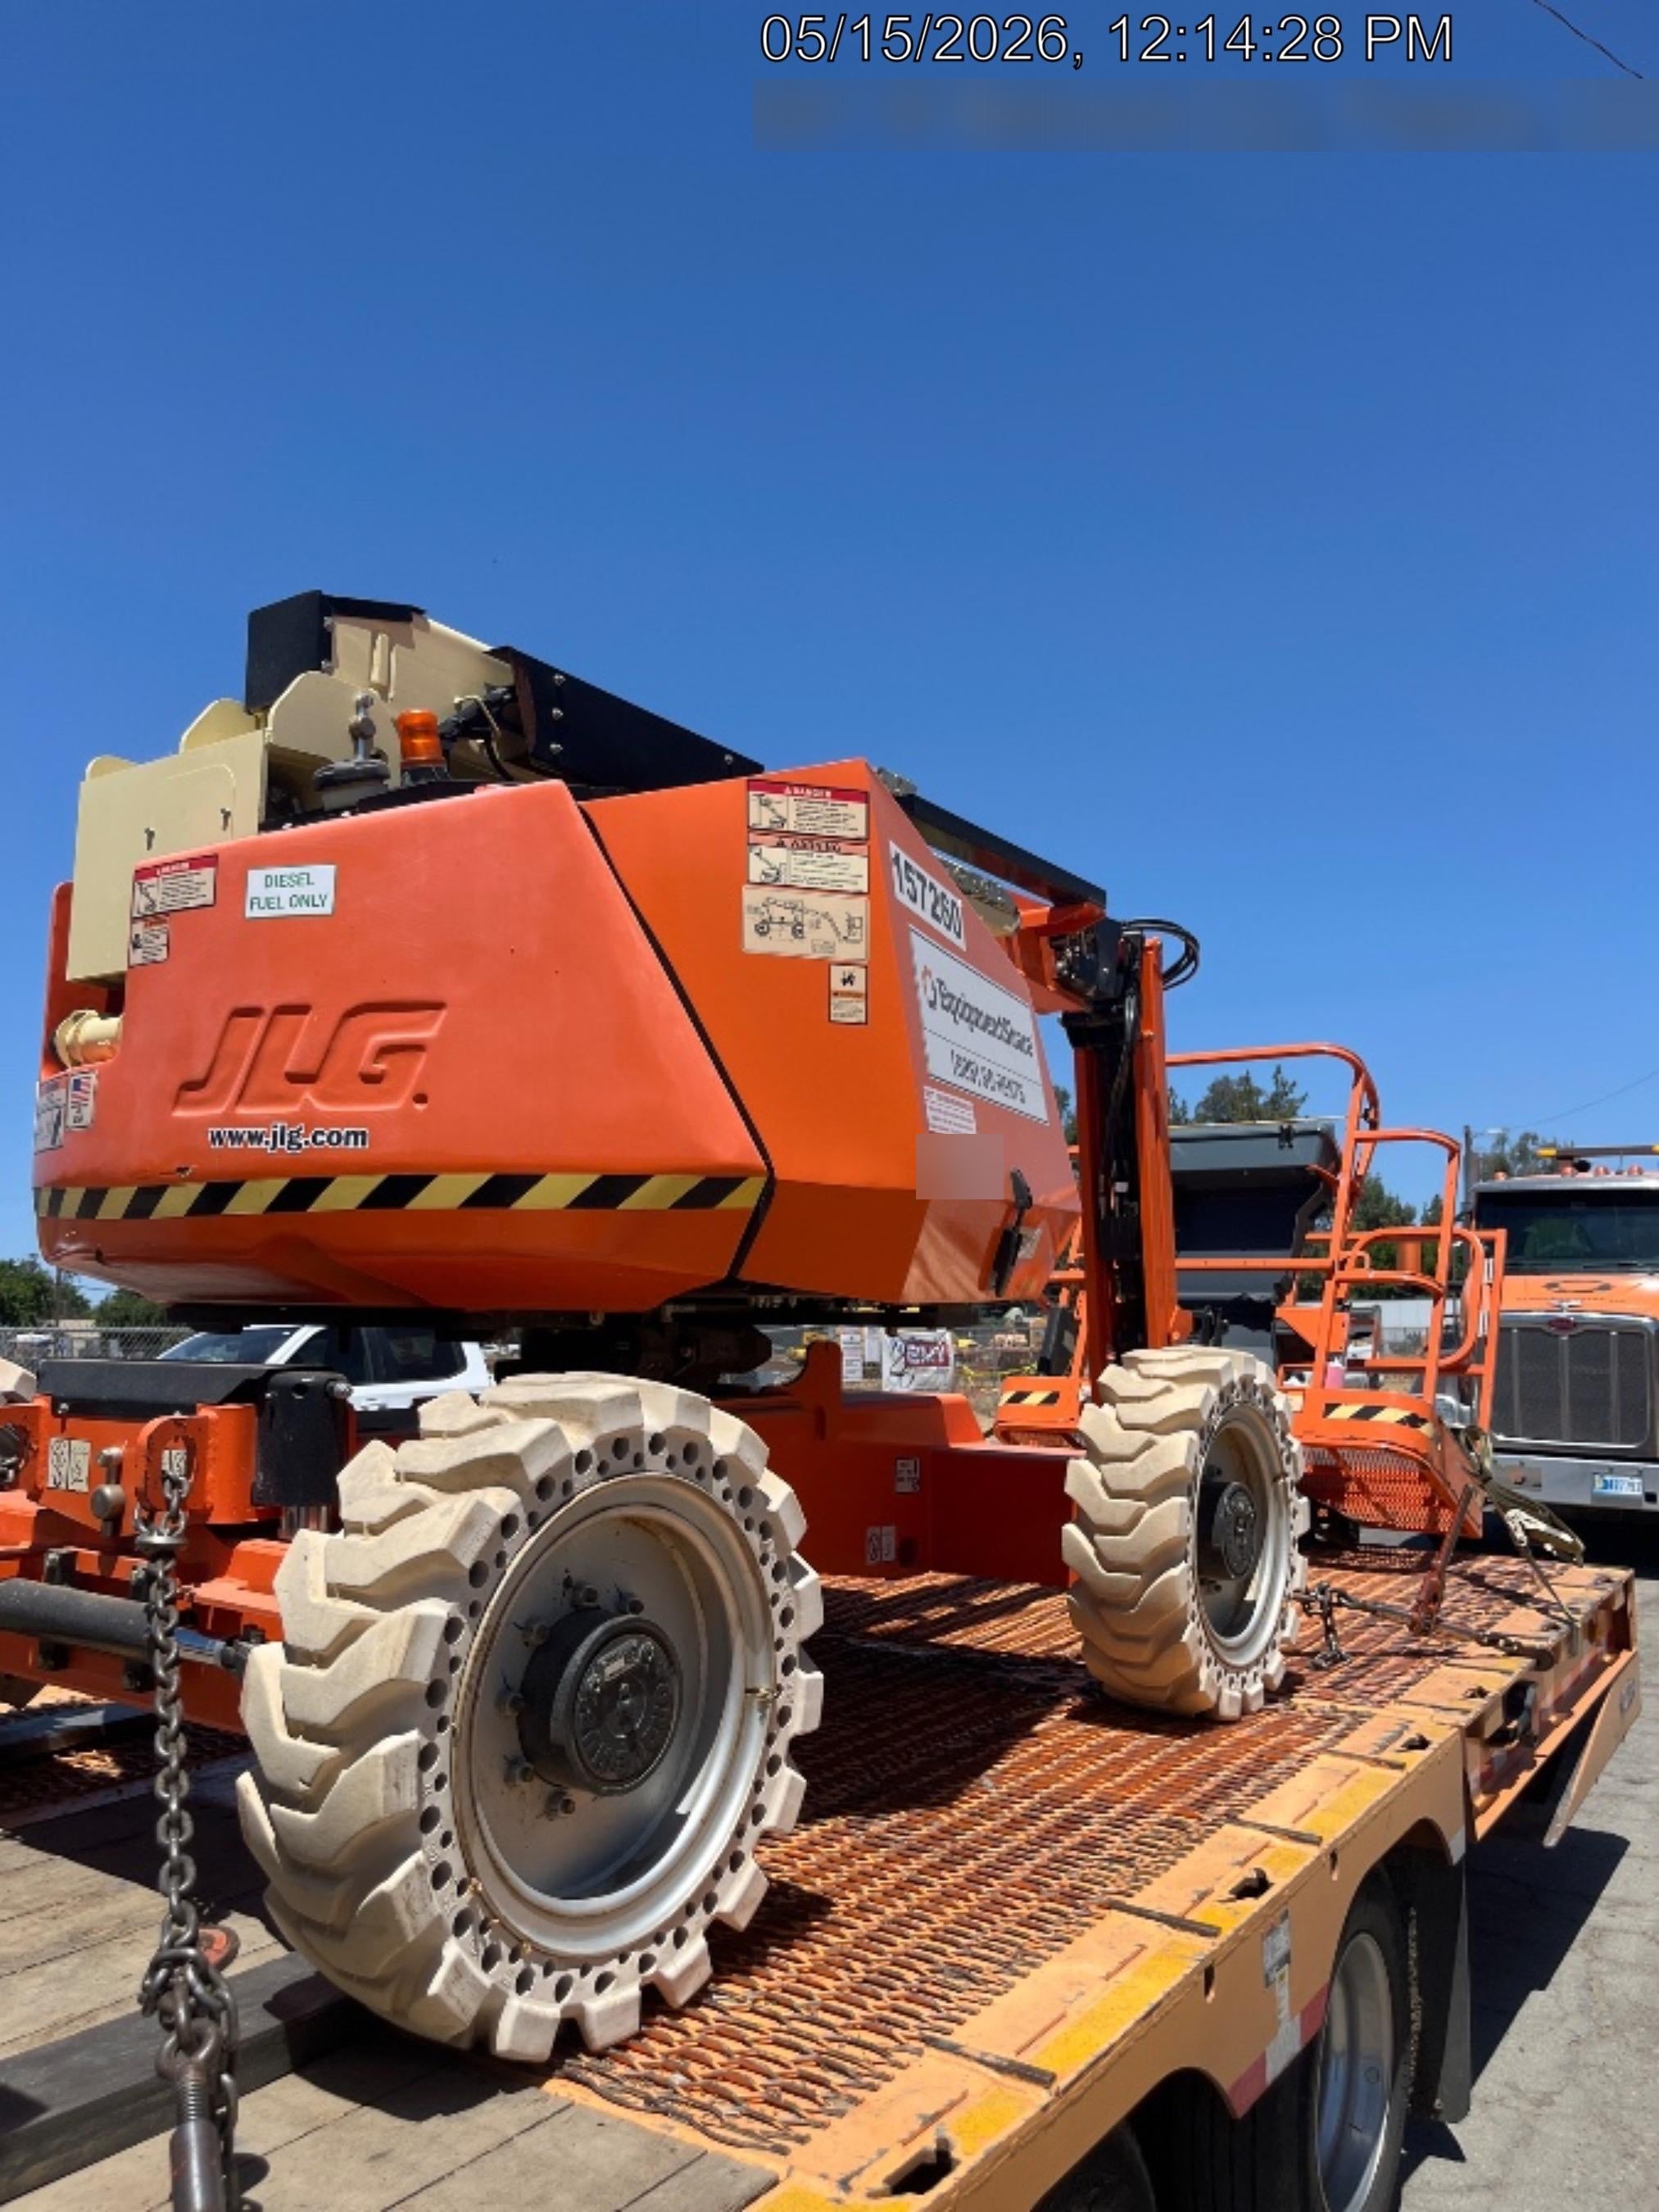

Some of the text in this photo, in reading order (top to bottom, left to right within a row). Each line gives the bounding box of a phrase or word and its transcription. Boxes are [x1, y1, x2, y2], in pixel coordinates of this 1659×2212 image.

[264, 873, 315, 888] DIESEL
[249, 894, 328, 911] FUEL ONLY
[891, 850, 962, 940] 157260
[208, 1122, 370, 1154] www.jlg.com
